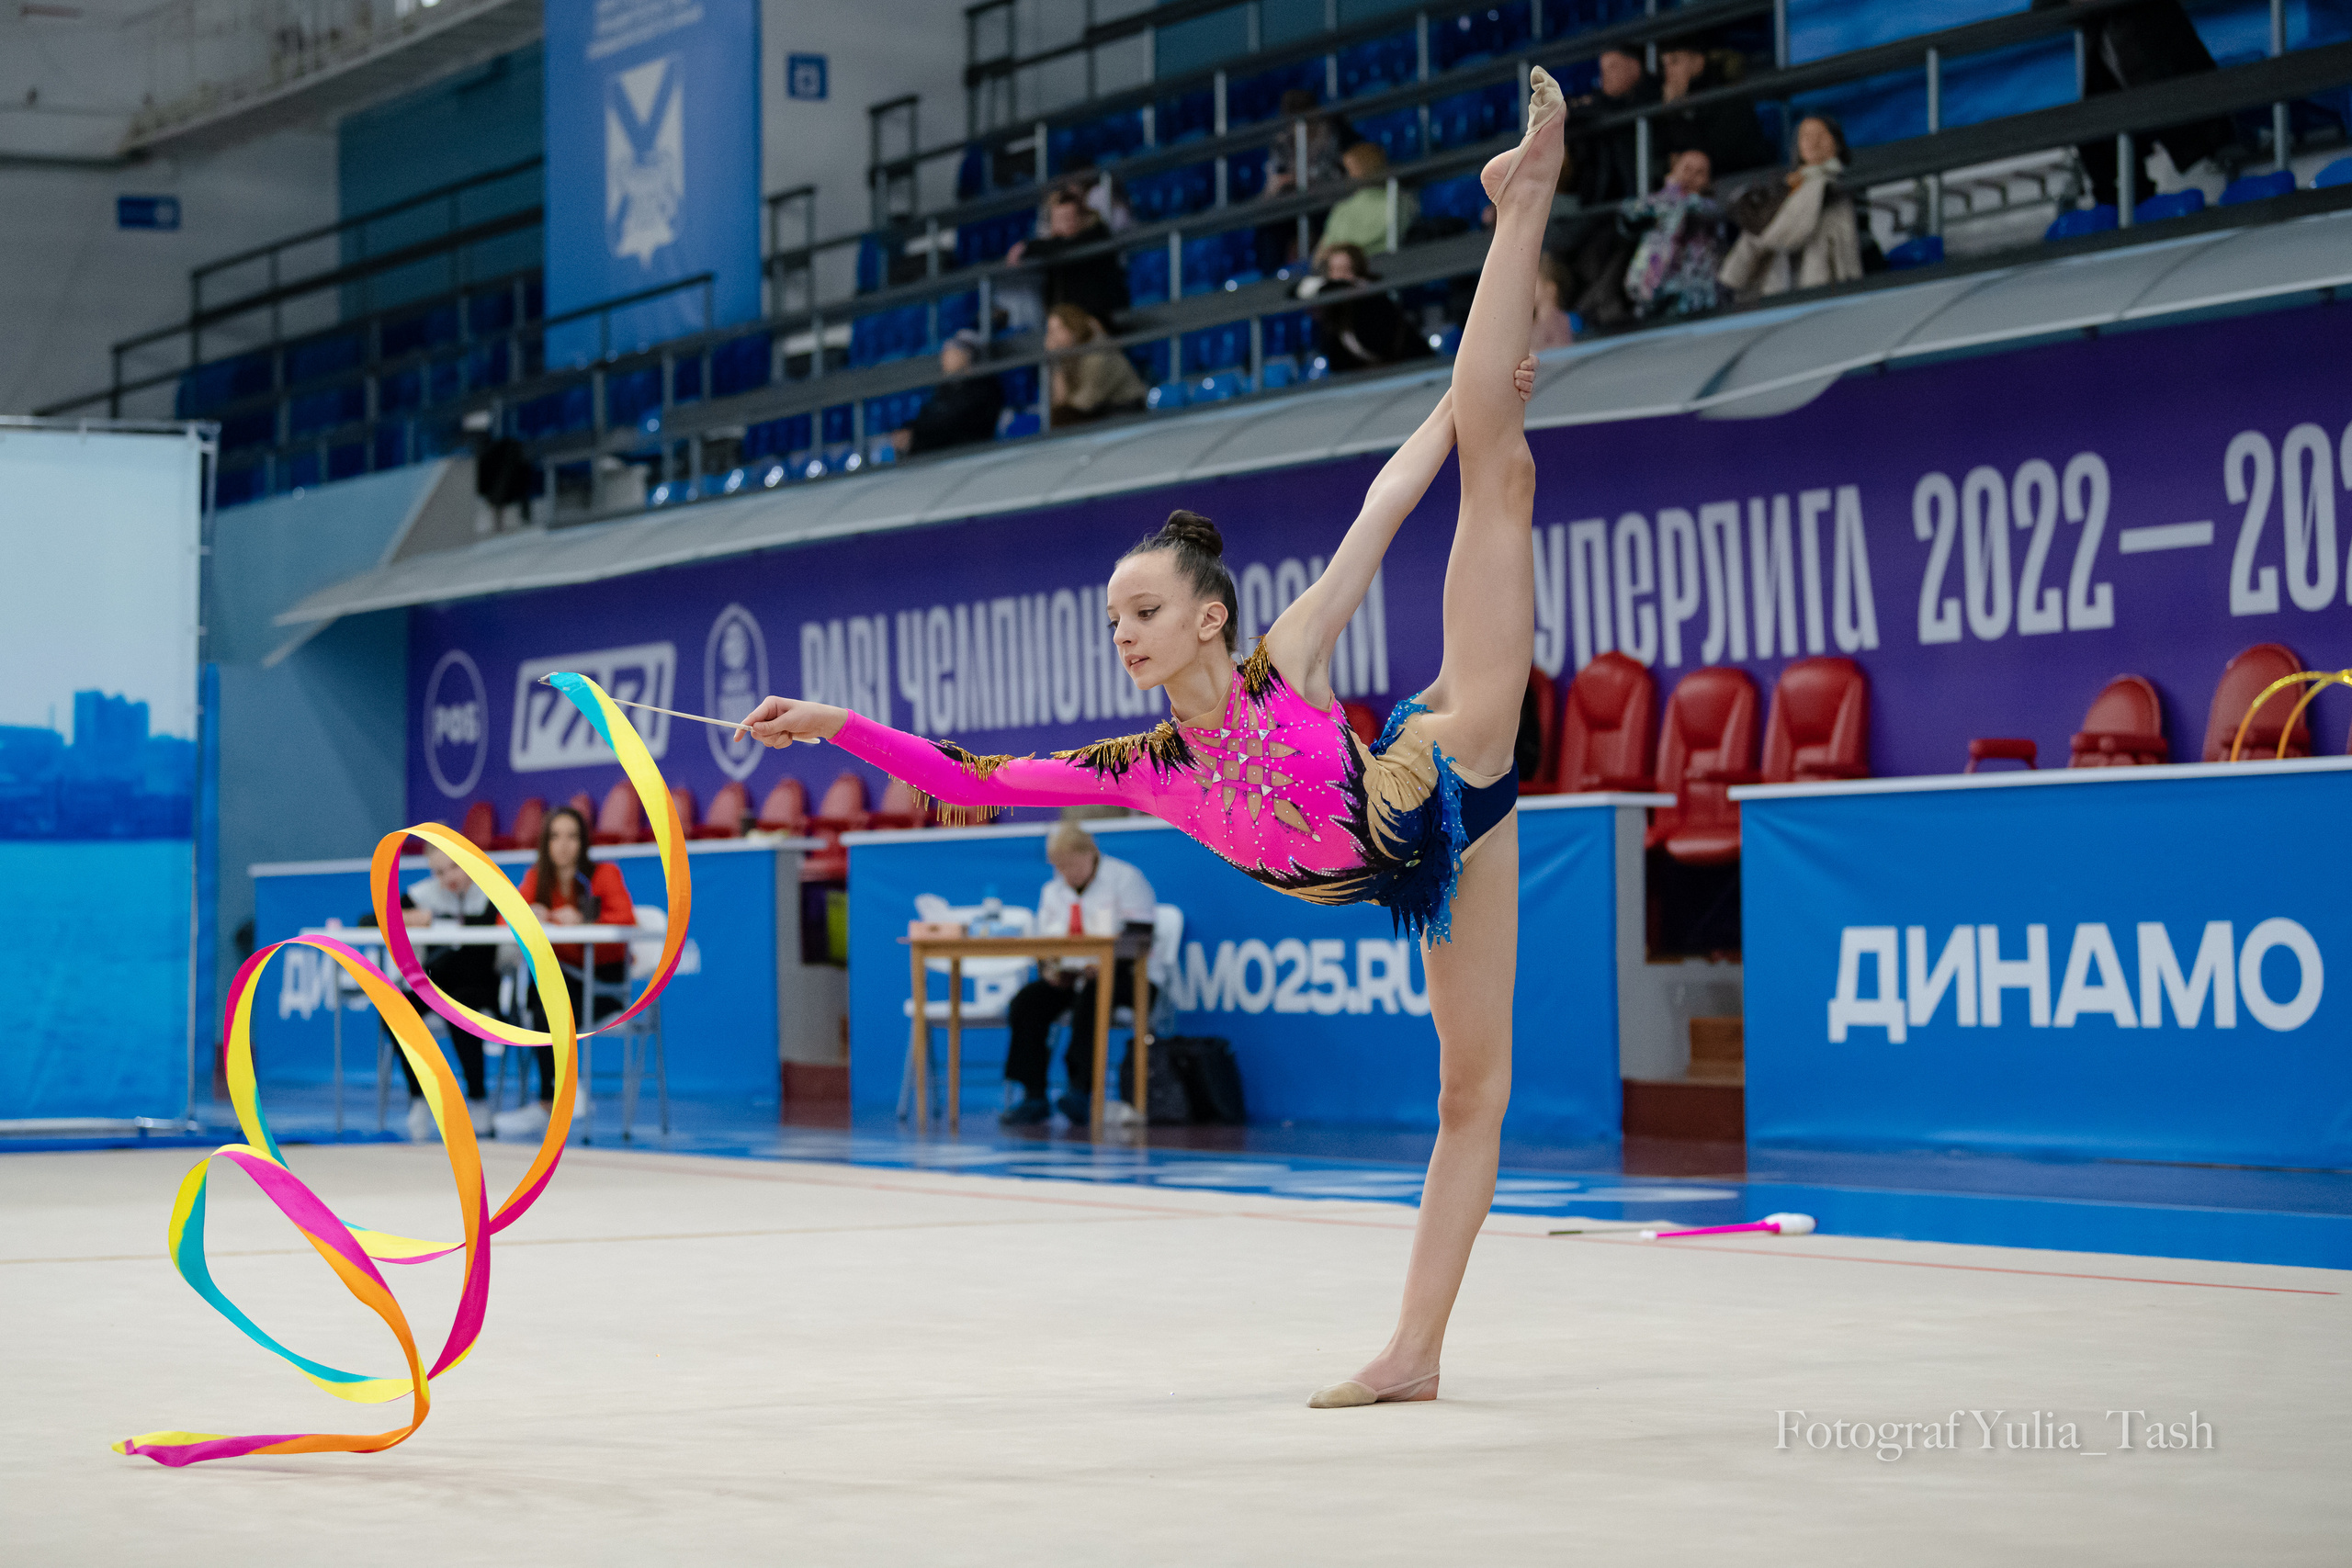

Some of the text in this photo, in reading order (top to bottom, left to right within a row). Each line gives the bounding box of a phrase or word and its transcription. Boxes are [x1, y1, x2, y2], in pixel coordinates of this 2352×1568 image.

[896, 584, 1162, 737] ЧЕМПИОН
[1532, 484, 1880, 680] УПЕРЛИГА
[1827, 917, 2324, 1044] ДИНАМО
